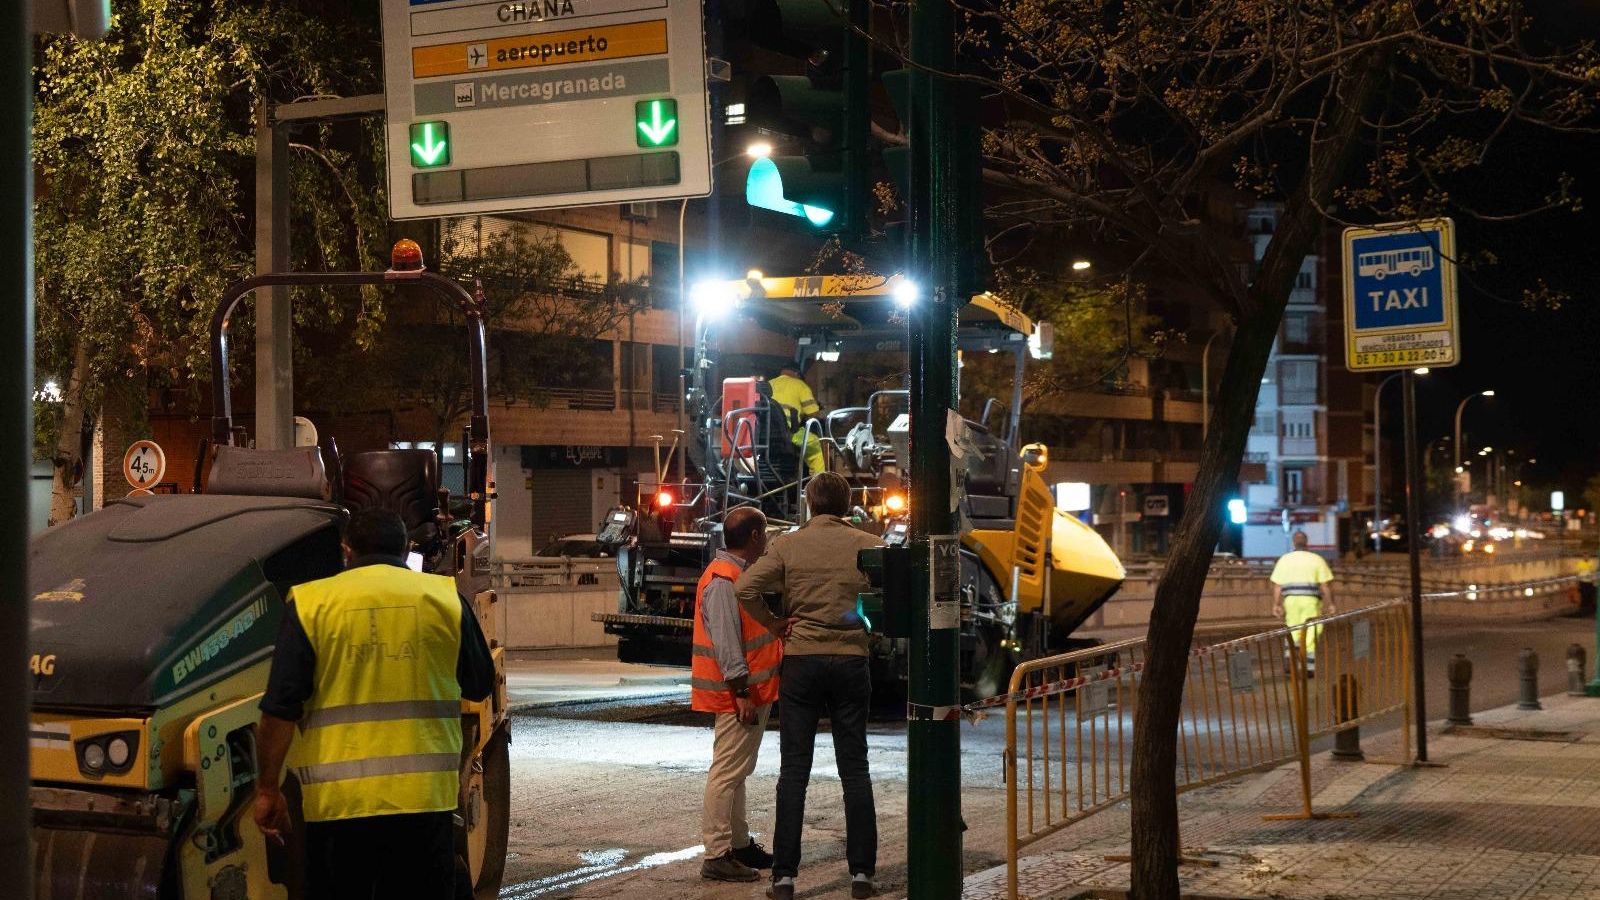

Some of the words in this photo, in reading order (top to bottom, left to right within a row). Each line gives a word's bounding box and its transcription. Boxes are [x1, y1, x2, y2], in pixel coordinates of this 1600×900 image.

[497, 0, 575, 22] CHANA
[496, 34, 608, 62] aeropuerto
[481, 72, 626, 101] Mercagranada
[1368, 287, 1428, 312] TAXI
[1357, 354, 1370, 365] DE
